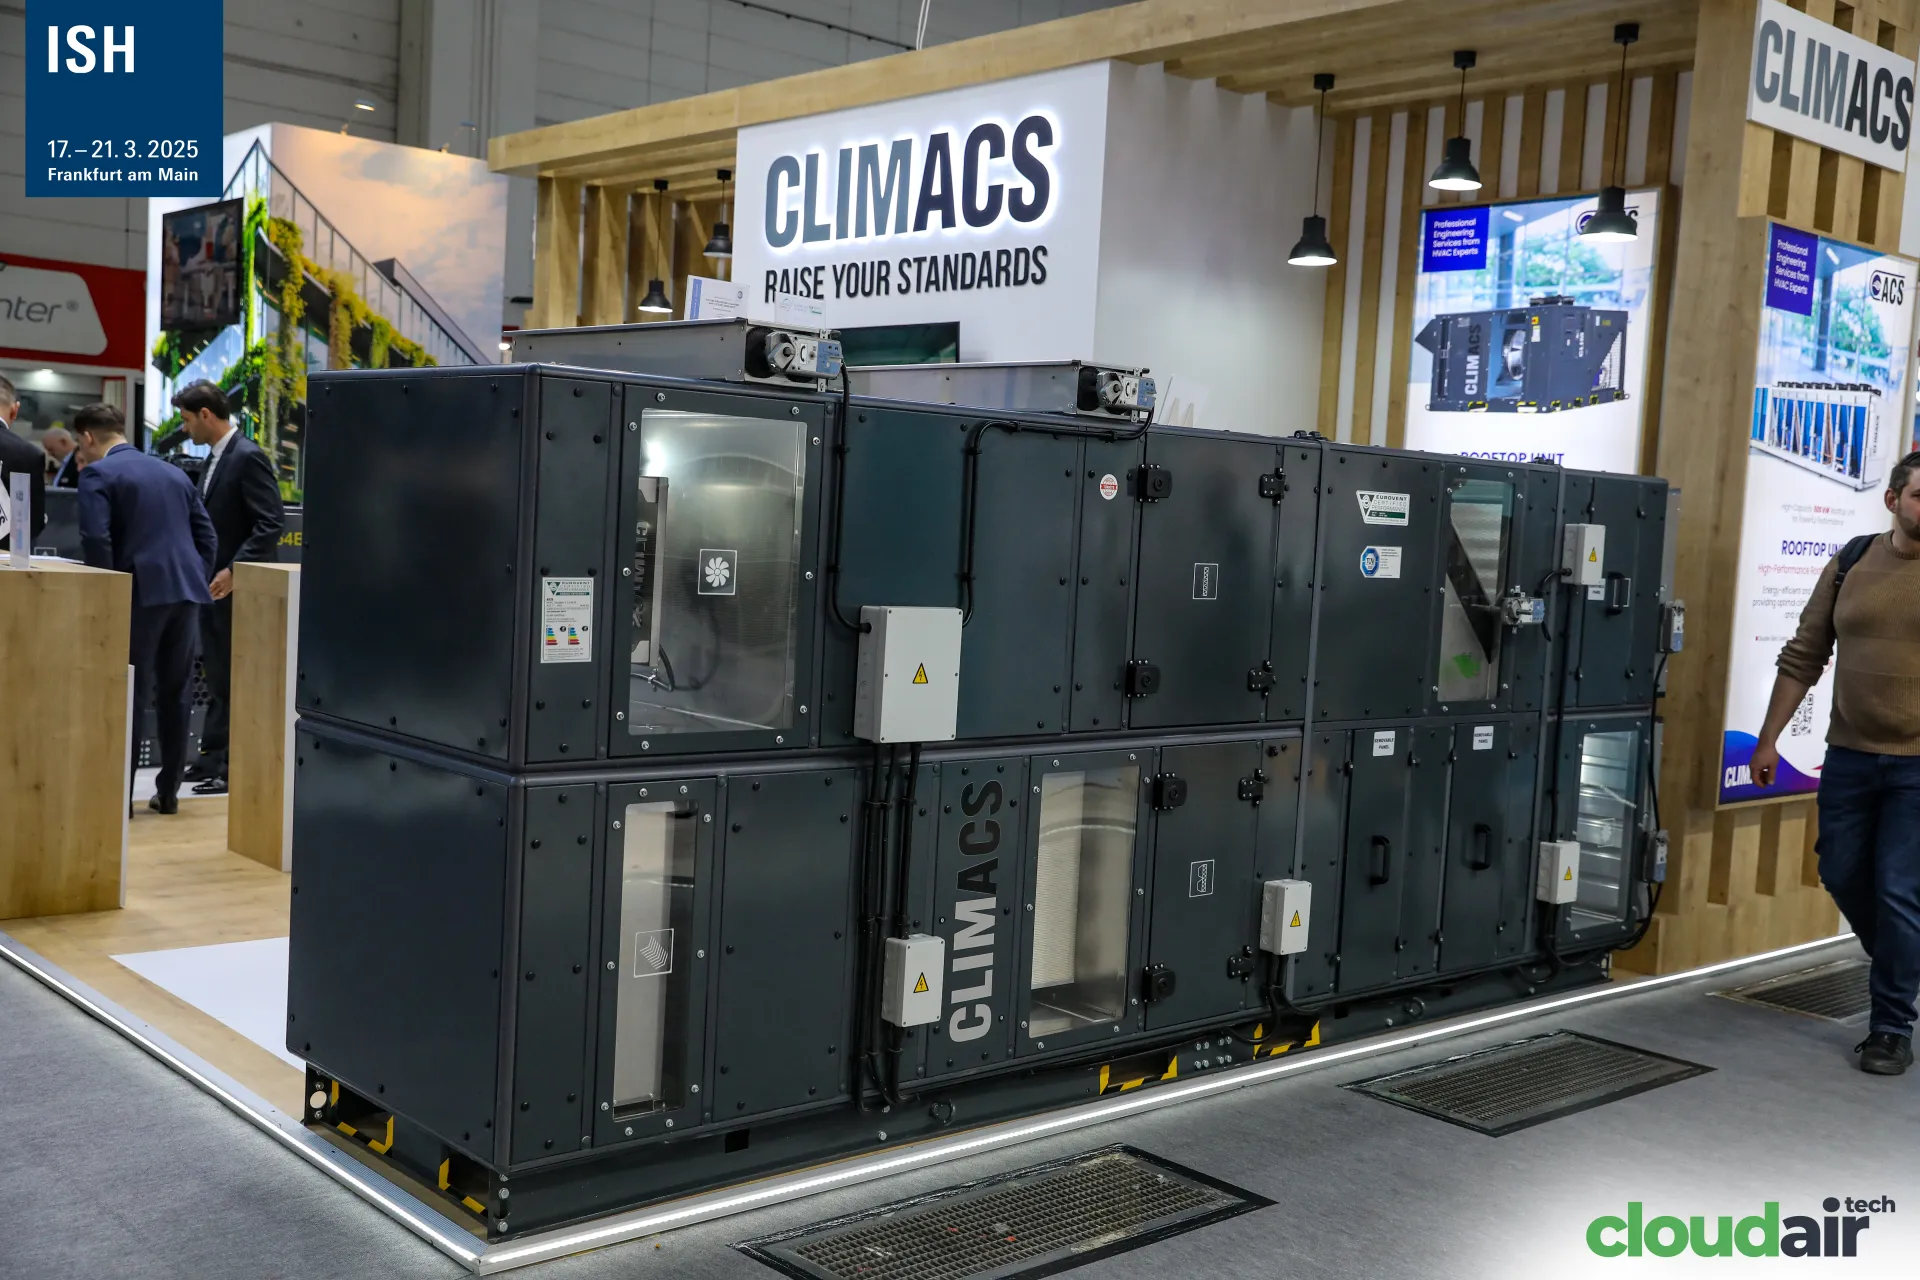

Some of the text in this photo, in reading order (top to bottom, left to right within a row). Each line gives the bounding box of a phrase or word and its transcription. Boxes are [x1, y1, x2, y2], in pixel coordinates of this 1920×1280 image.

[1755, 19, 1914, 151] CLIMACS
[765, 115, 1054, 248] CLIMACS
[1433, 218, 1477, 229] Professional
[1432, 238, 1480, 248] Services from
[1433, 228, 1475, 240] Engineering
[1432, 247, 1479, 258] HVAC Experts
[1777, 239, 1809, 257] Professional
[1776, 252, 1807, 271] Engineering
[765, 245, 1048, 303] RAISE YOUR STANDARDS
[1775, 265, 1810, 283] Services from
[1774, 278, 1809, 295] HVAC Experts
[1881, 277, 1906, 306] ACS
[1464, 323, 1481, 396] CLIMACS
[1375, 494, 1408, 502] EUROVENT
[1781, 540, 1827, 557] ROOFTOP
[949, 779, 1004, 1043] CLIMACS
